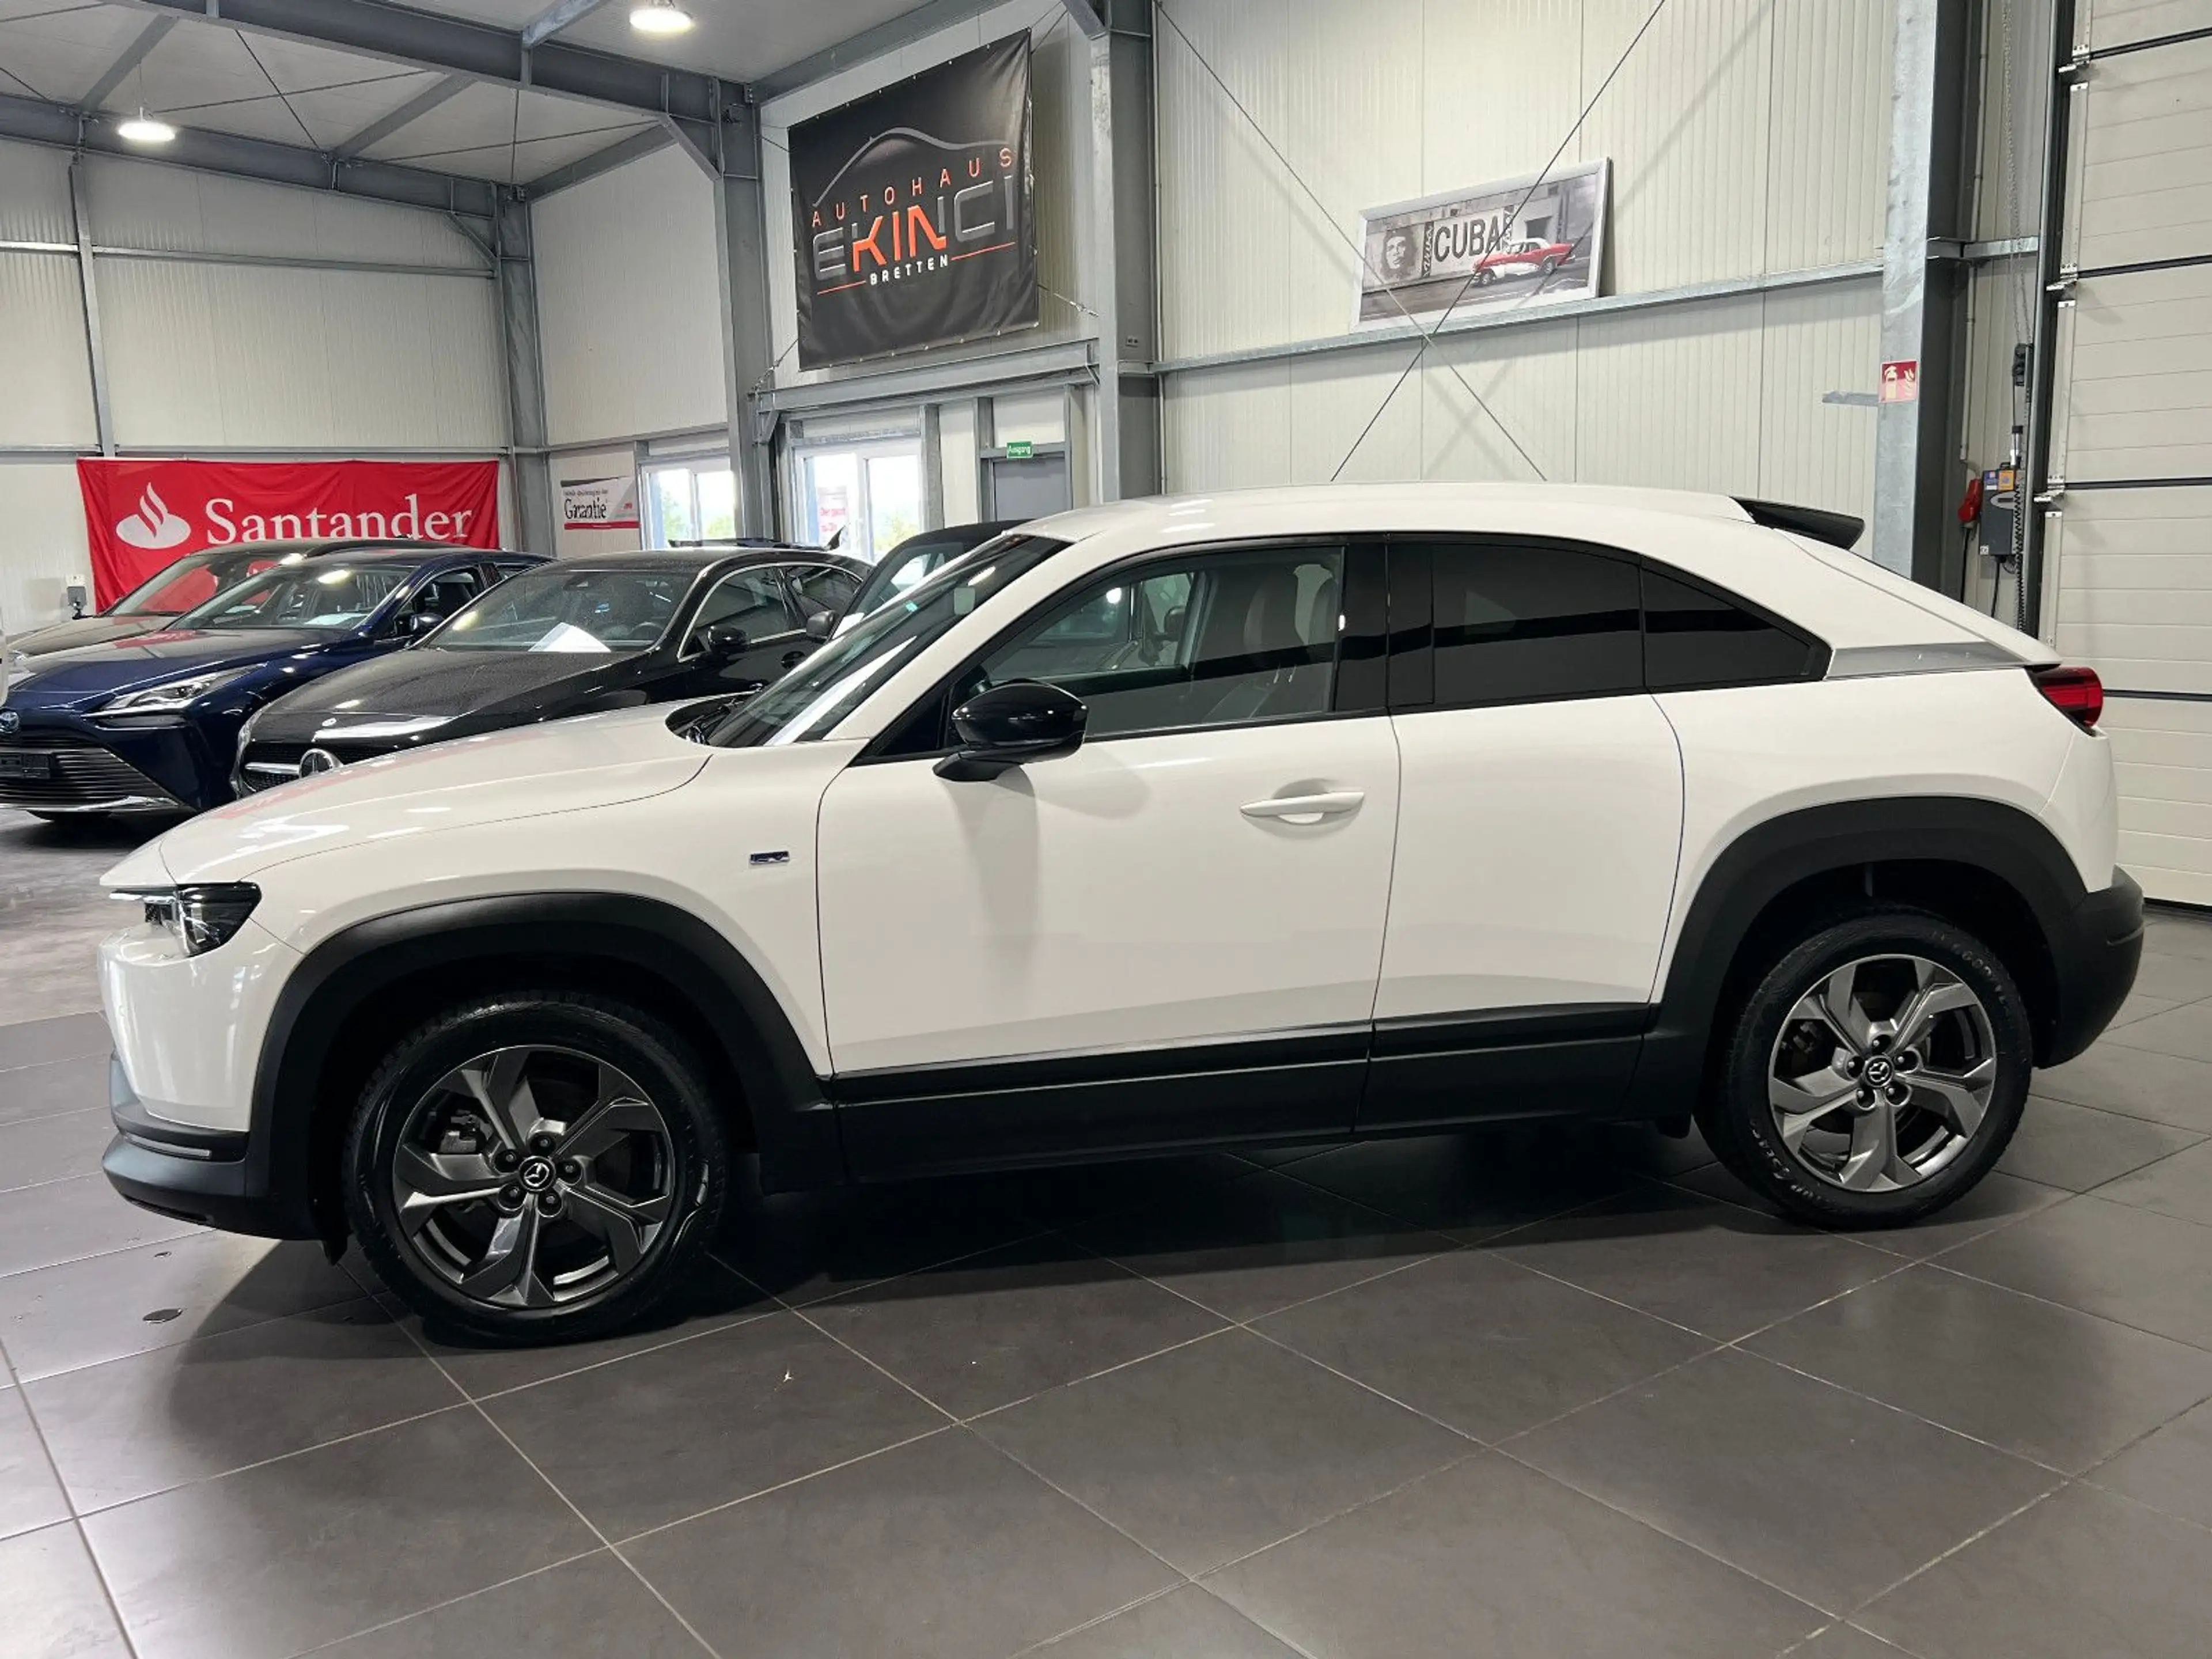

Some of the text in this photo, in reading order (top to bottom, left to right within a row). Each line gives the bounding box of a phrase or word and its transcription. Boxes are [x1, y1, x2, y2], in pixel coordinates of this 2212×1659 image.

[812, 147, 1013, 228] AUTOHAUS
[812, 175, 1018, 281] EKINCI
[1434, 215, 1501, 262] CUBA
[870, 254, 949, 285] BRETTEN
[206, 494, 472, 544] Santander
